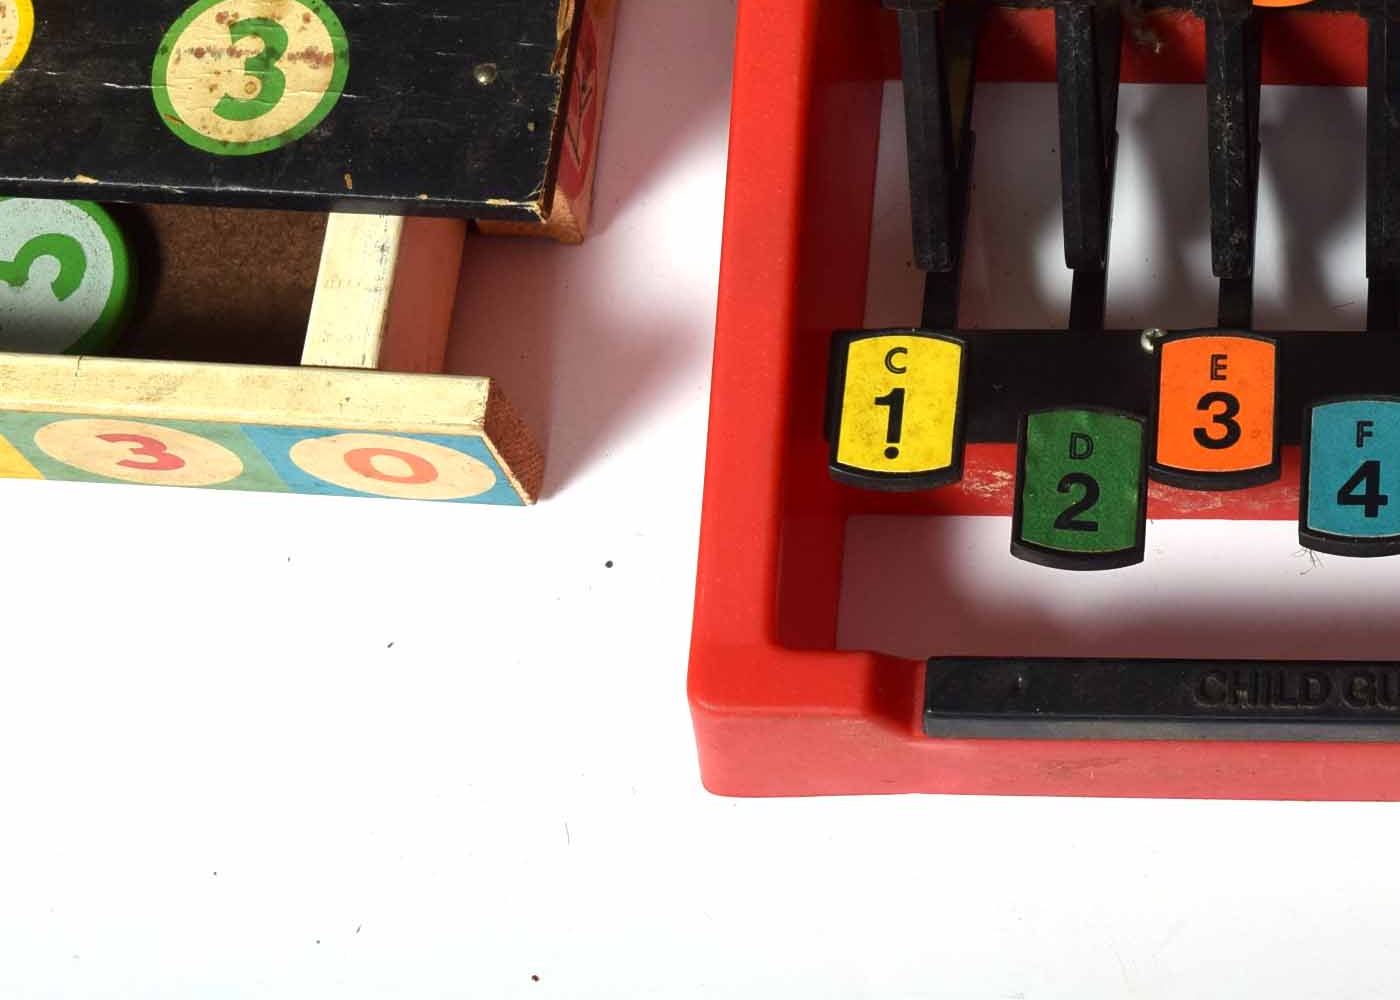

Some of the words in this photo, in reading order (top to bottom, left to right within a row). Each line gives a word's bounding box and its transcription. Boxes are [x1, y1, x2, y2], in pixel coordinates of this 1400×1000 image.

[212, 17, 289, 121] 3
[884, 347, 908, 374] C
[1210, 354, 1228, 380] E
[1193, 391, 1242, 450] 3
[1356, 420, 1374, 448] F
[95, 432, 186, 472] 3
[343, 447, 439, 485] 0
[1069, 432, 1094, 460] D
[1053, 472, 1101, 532] 2
[1336, 460, 1388, 518] 4
[1194, 668, 1332, 709] CHILD
